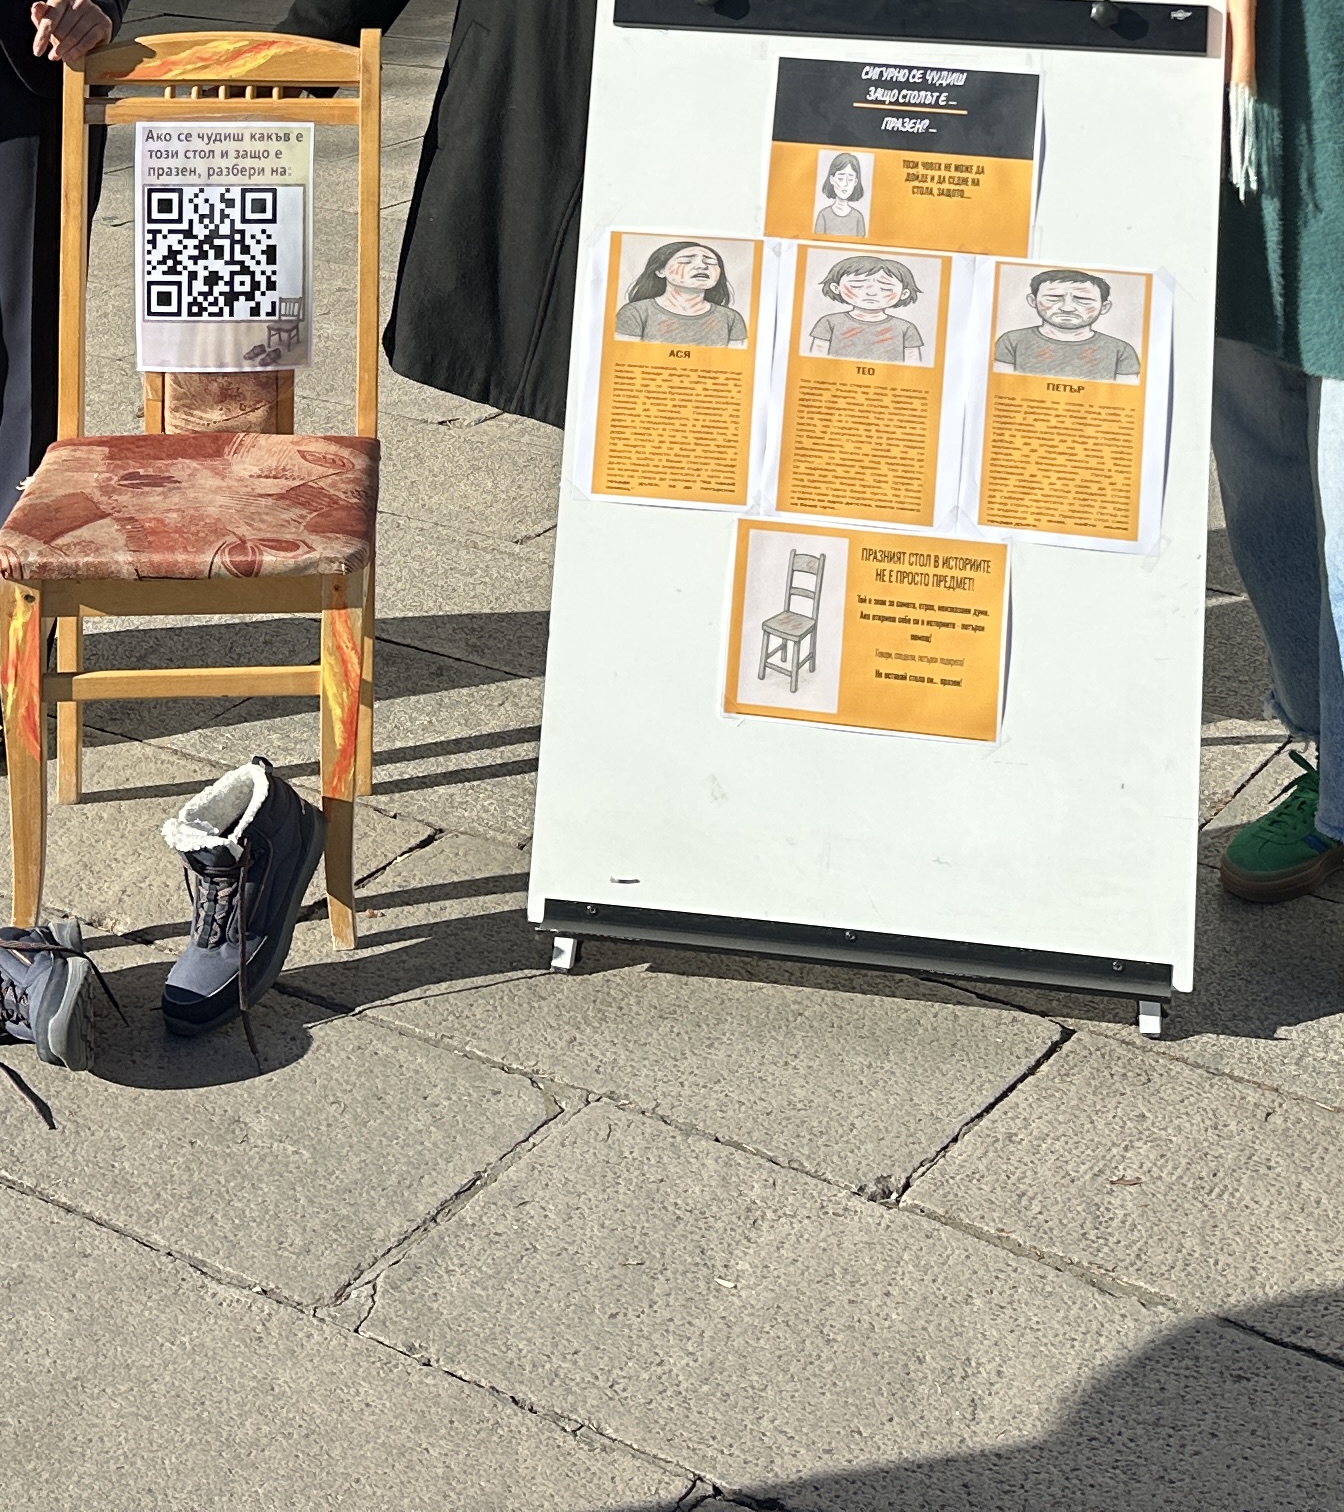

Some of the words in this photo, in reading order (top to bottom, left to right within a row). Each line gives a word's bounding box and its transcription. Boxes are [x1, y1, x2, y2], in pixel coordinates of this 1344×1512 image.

[861, 66, 908, 82] СИГУРНО
[909, 69, 923, 83] СЕ
[925, 70, 968, 86] ЧУДИШ
[866, 86, 898, 104] ЗАЩО
[898, 89, 939, 105] СТОЛЪТ
[939, 93, 947, 106] Е
[145, 130, 172, 143] Ако
[177, 132, 193, 143] се
[197, 131, 244, 145] чудиш
[249, 132, 290, 143] какъв
[296, 133, 304, 143] е
[148, 149, 179, 160] този
[184, 149, 215, 160] стол
[220, 149, 229, 160] и
[234, 148, 270, 162] защо
[274, 149, 283, 160] е
[147, 165, 202, 179] празен,
[207, 164, 265, 179] разбери
[944, 162, 952, 172] НЕ
[974, 165, 985, 175] ДА
[936, 175, 946, 185] ДА
[668, 350, 691, 359] АСЯ
[856, 366, 875, 376] ТЕО
[1046, 382, 1085, 394] ПЕТЪР
[861, 547, 906, 564] ПРАЗНИЯТ
[908, 552, 932, 568] СТОЛ
[934, 555, 939, 568] В
[941, 555, 992, 573] ИСТОРИИТЕ
[875, 568, 886, 583] НЕ
[889, 570, 893, 583] Е
[895, 570, 930, 587] ПРОСТО
[932, 573, 975, 591] ПРЕДМЕТ!
